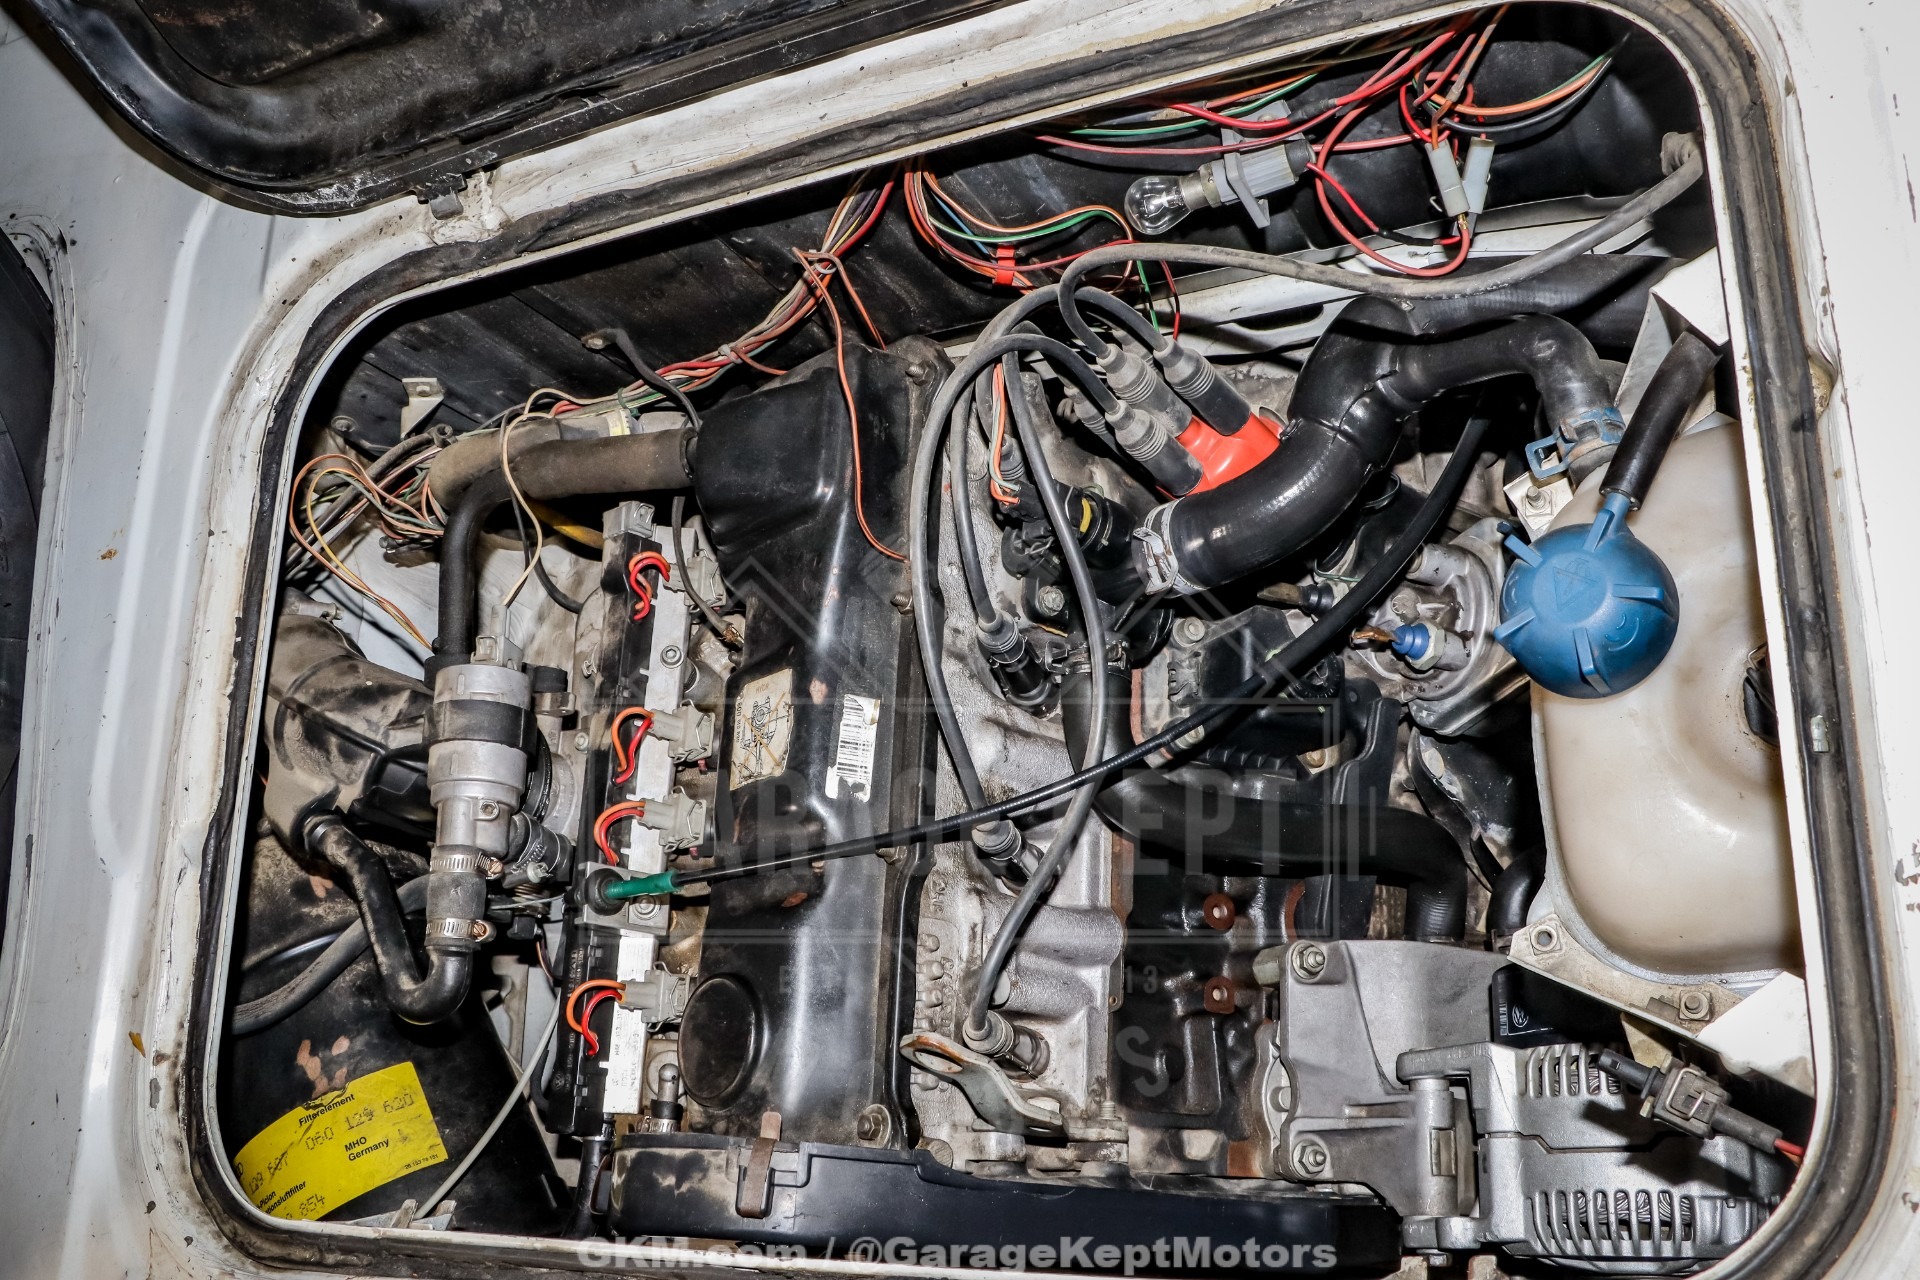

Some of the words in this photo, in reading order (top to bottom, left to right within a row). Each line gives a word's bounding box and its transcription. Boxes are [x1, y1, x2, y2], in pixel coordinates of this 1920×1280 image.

[298, 1093, 356, 1128] Filterelement
[344, 1136, 367, 1153] MHO
[348, 1138, 390, 1162] Germany
